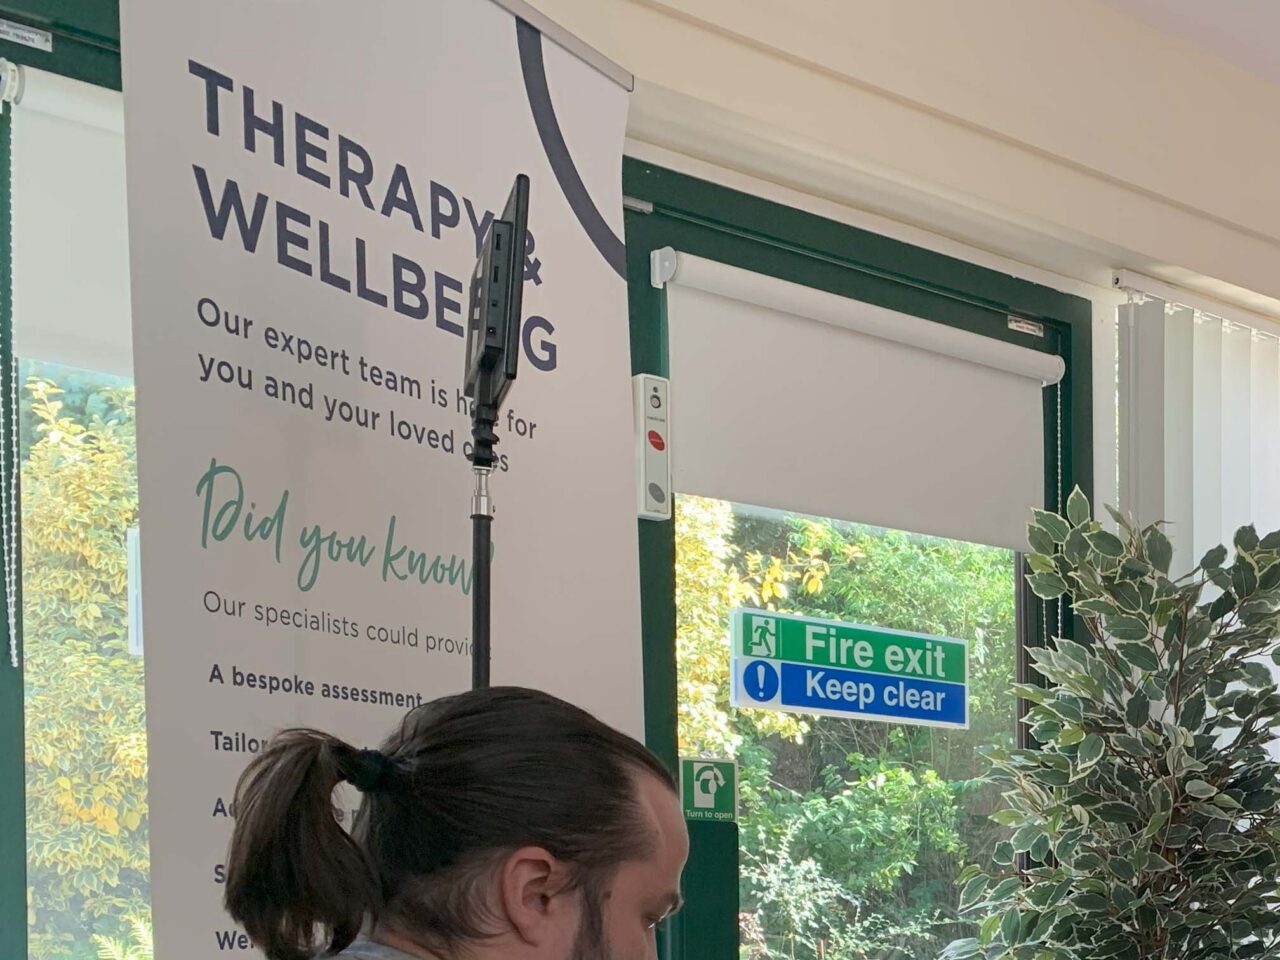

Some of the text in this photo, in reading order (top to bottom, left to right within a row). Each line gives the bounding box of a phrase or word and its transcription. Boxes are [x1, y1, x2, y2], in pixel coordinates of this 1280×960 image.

[188, 59, 495, 260] THERAPY
[192, 164, 557, 372] WELLBEG
[197, 297, 253, 339] Our
[264, 327, 350, 376] expert
[359, 356, 421, 400] team
[431, 379, 448, 408] is
[507, 409, 537, 439] for
[198, 353, 253, 391] you
[264, 375, 313, 411] and
[323, 395, 380, 431] your
[390, 410, 454, 454] loved
[196, 457, 290, 564] Did
[297, 524, 376, 592] you
[203, 590, 246, 618] Our
[254, 603, 360, 638] specialists
[366, 625, 419, 648] could
[805, 624, 946, 678] Fire exit
[209, 663, 423, 709] A bespoke assessment
[806, 669, 946, 712] Keep clear
[685, 809, 733, 821] Turn to open
